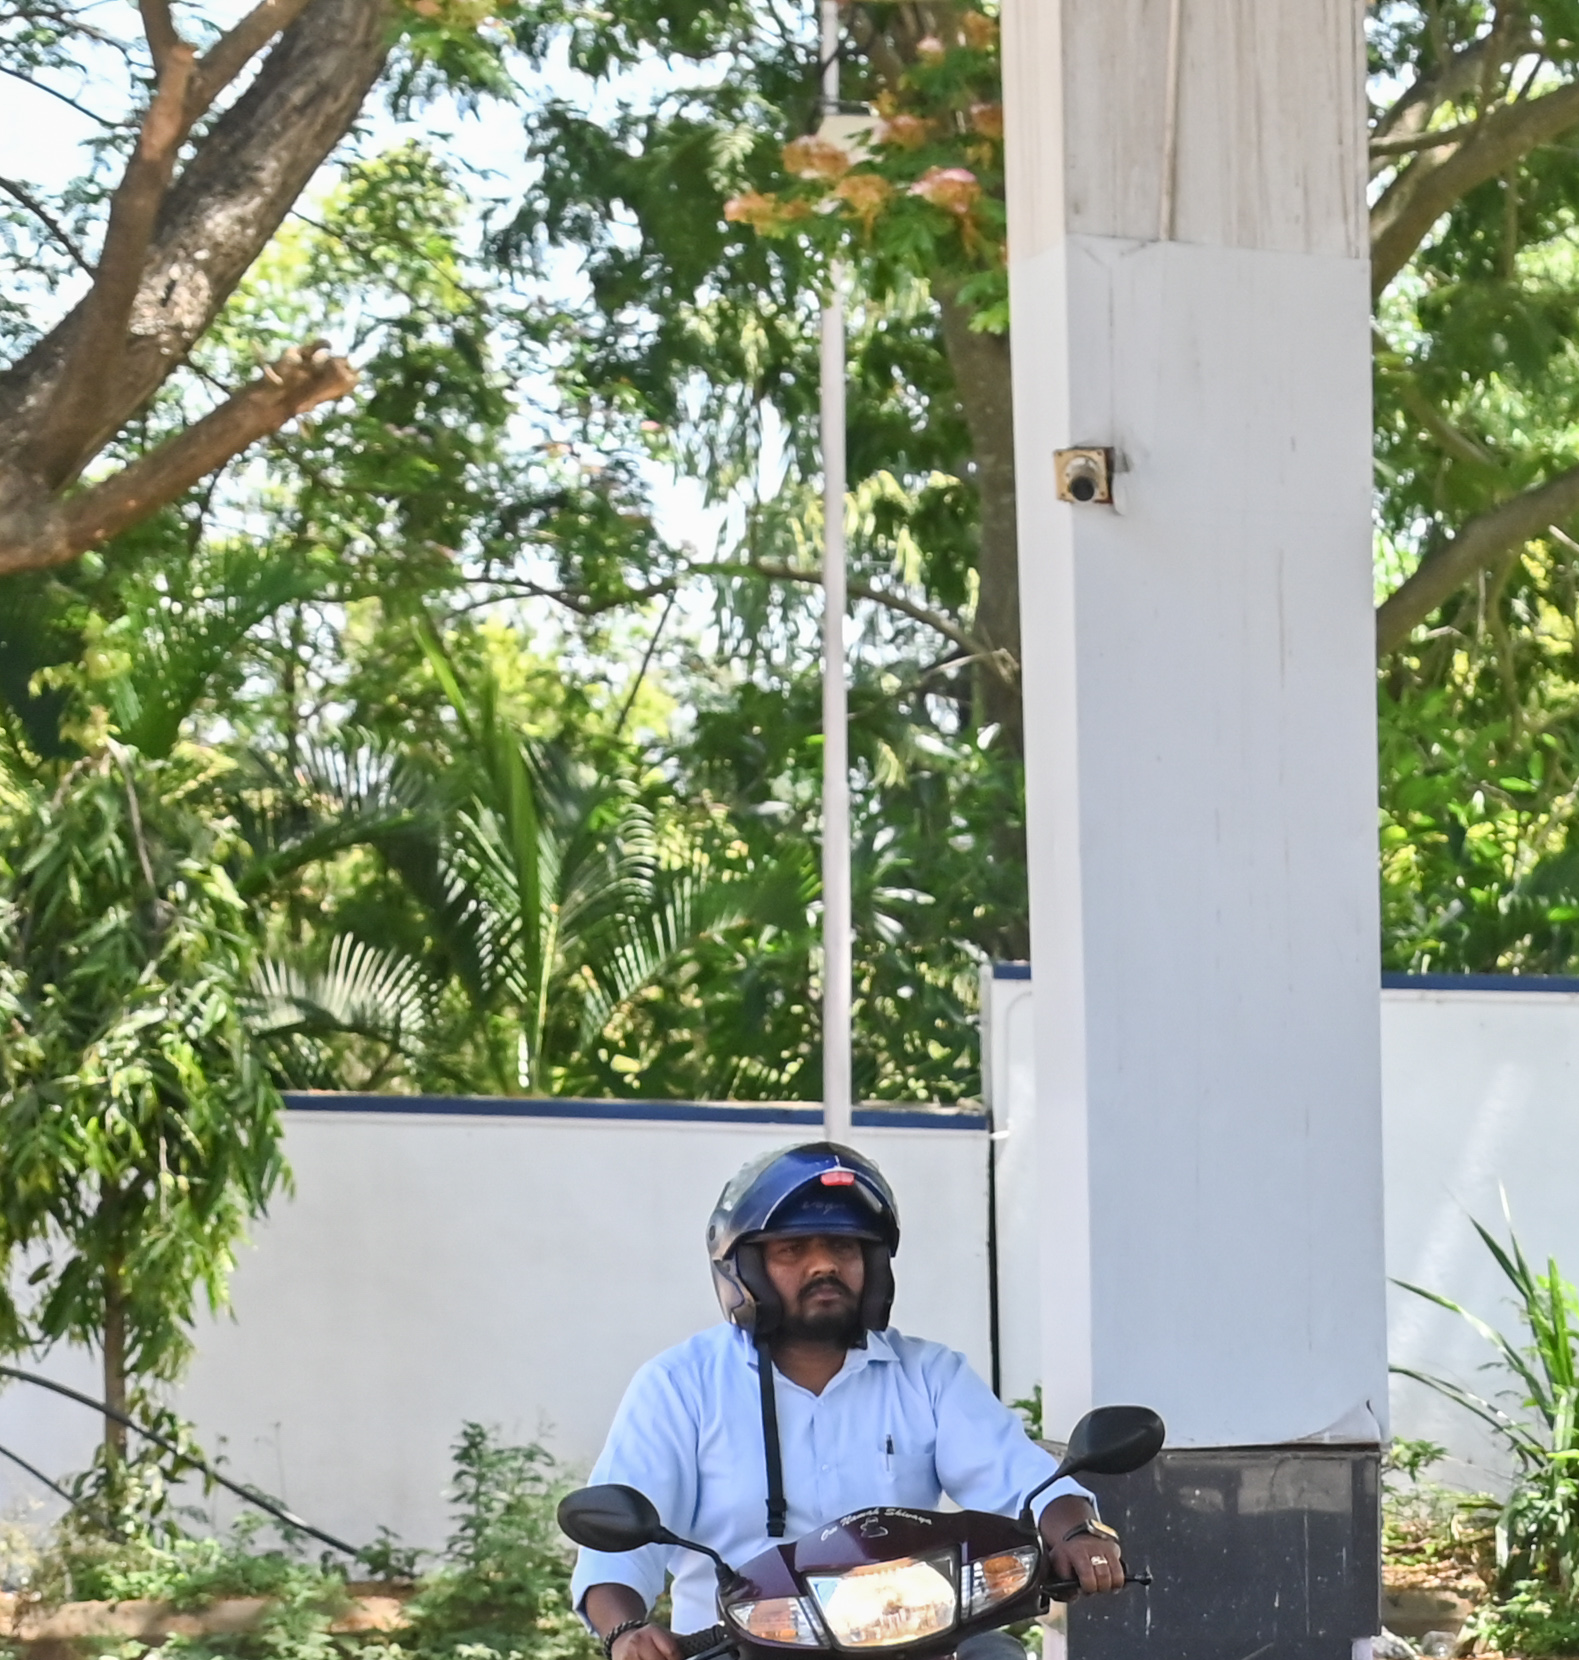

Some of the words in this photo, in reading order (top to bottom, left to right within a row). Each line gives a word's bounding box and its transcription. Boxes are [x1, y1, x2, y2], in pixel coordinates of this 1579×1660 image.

[821, 1526, 838, 1541] Om
[840, 1507, 880, 1526] Namah
[884, 1508, 932, 1525] Shivaya
